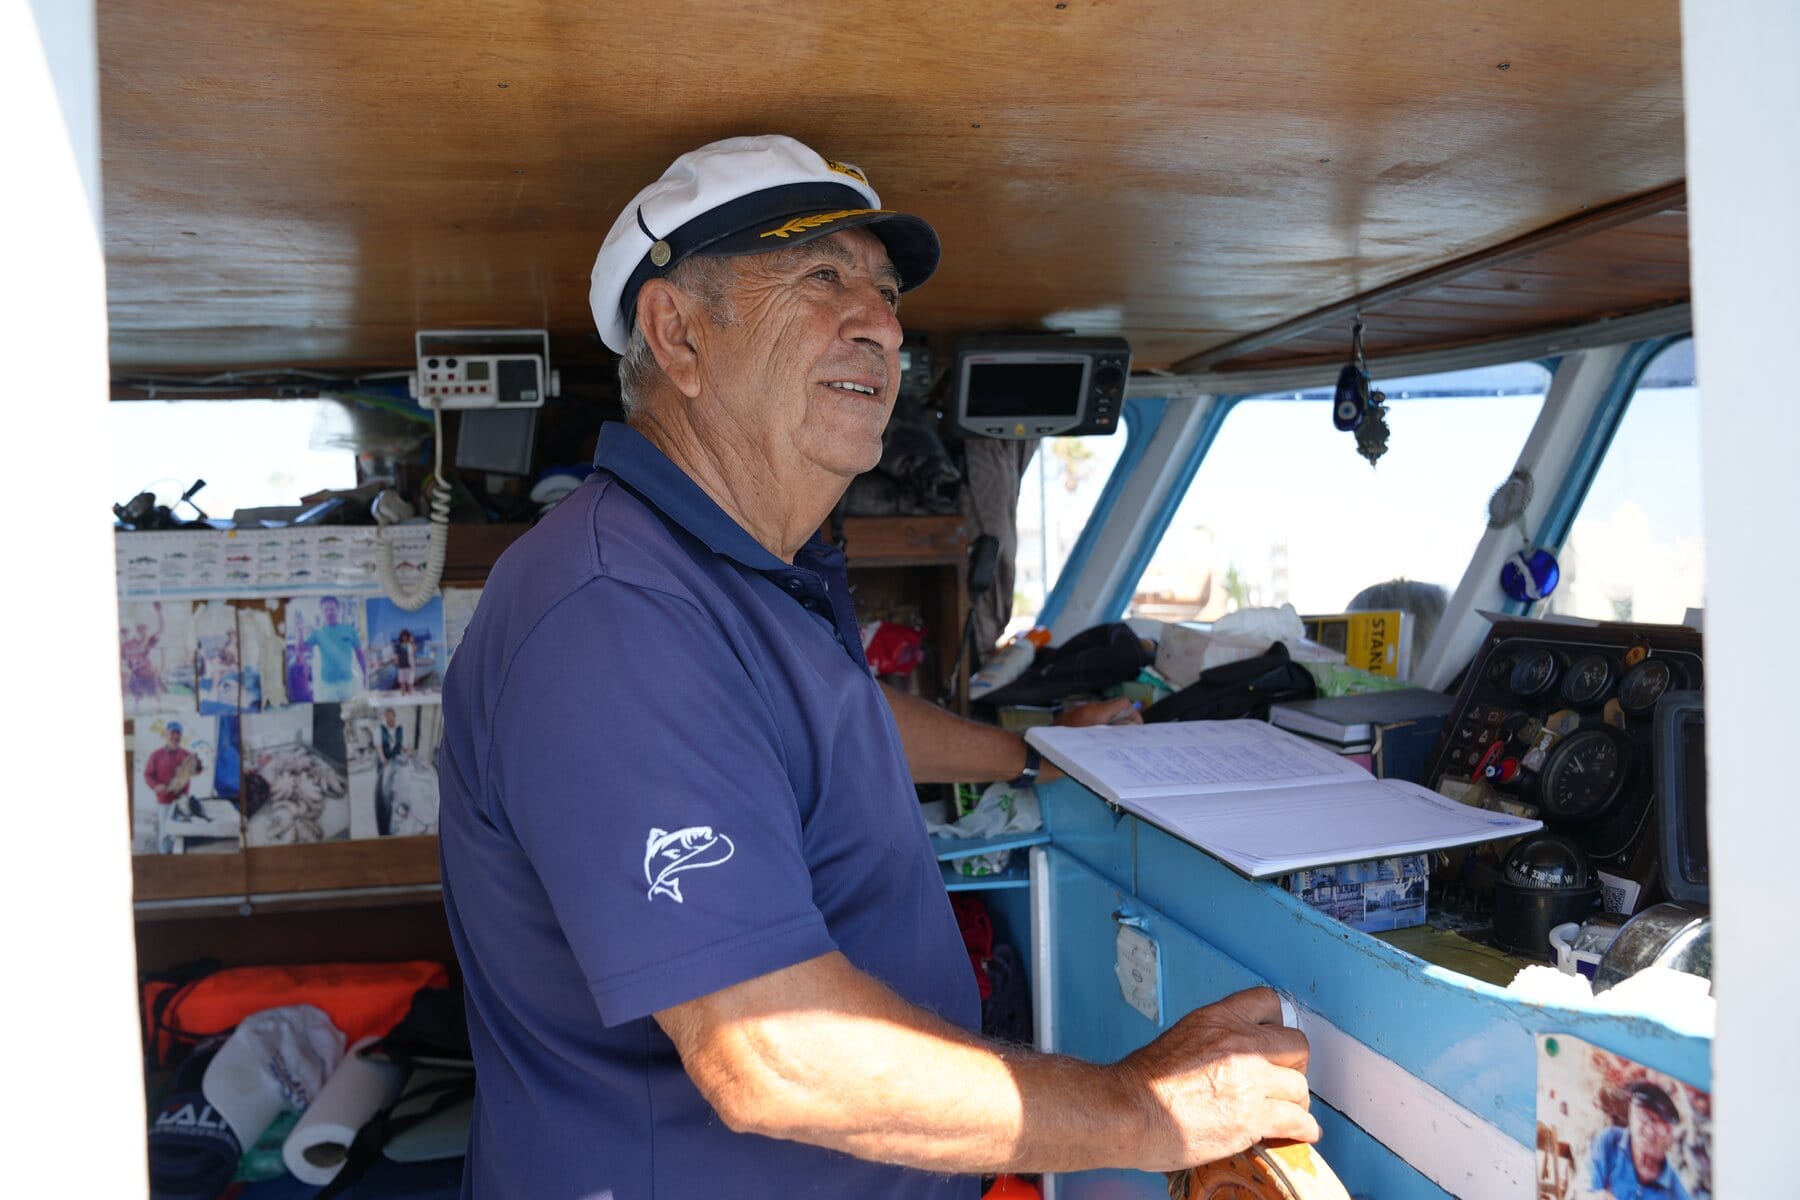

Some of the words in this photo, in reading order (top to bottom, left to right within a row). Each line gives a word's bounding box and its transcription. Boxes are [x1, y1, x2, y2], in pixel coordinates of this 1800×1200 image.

[1520, 863, 1529, 874] N
[1531, 869, 1546, 881] 330
[1547, 873, 1561, 884] 300
[1564, 874, 1574, 885] W
